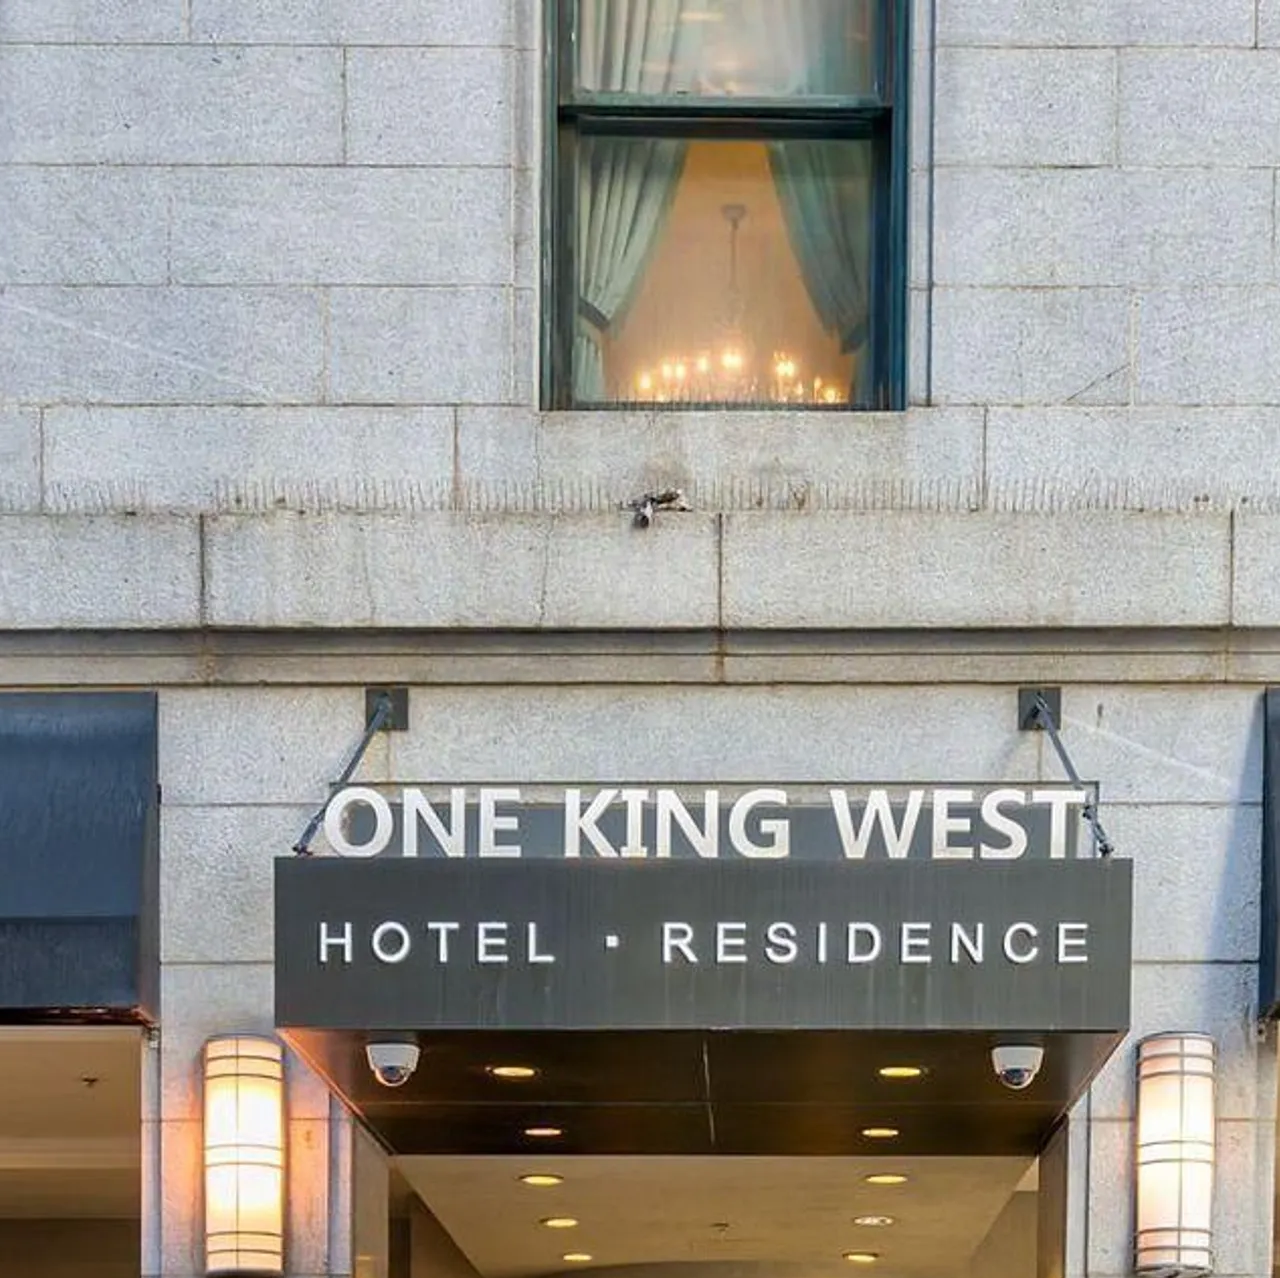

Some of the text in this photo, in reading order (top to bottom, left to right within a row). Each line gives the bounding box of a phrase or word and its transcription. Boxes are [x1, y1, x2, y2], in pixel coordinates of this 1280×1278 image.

[324, 786, 1086, 859] ONE KING WEST
[319, 920, 1089, 964] HOTEL RESIDENCE
